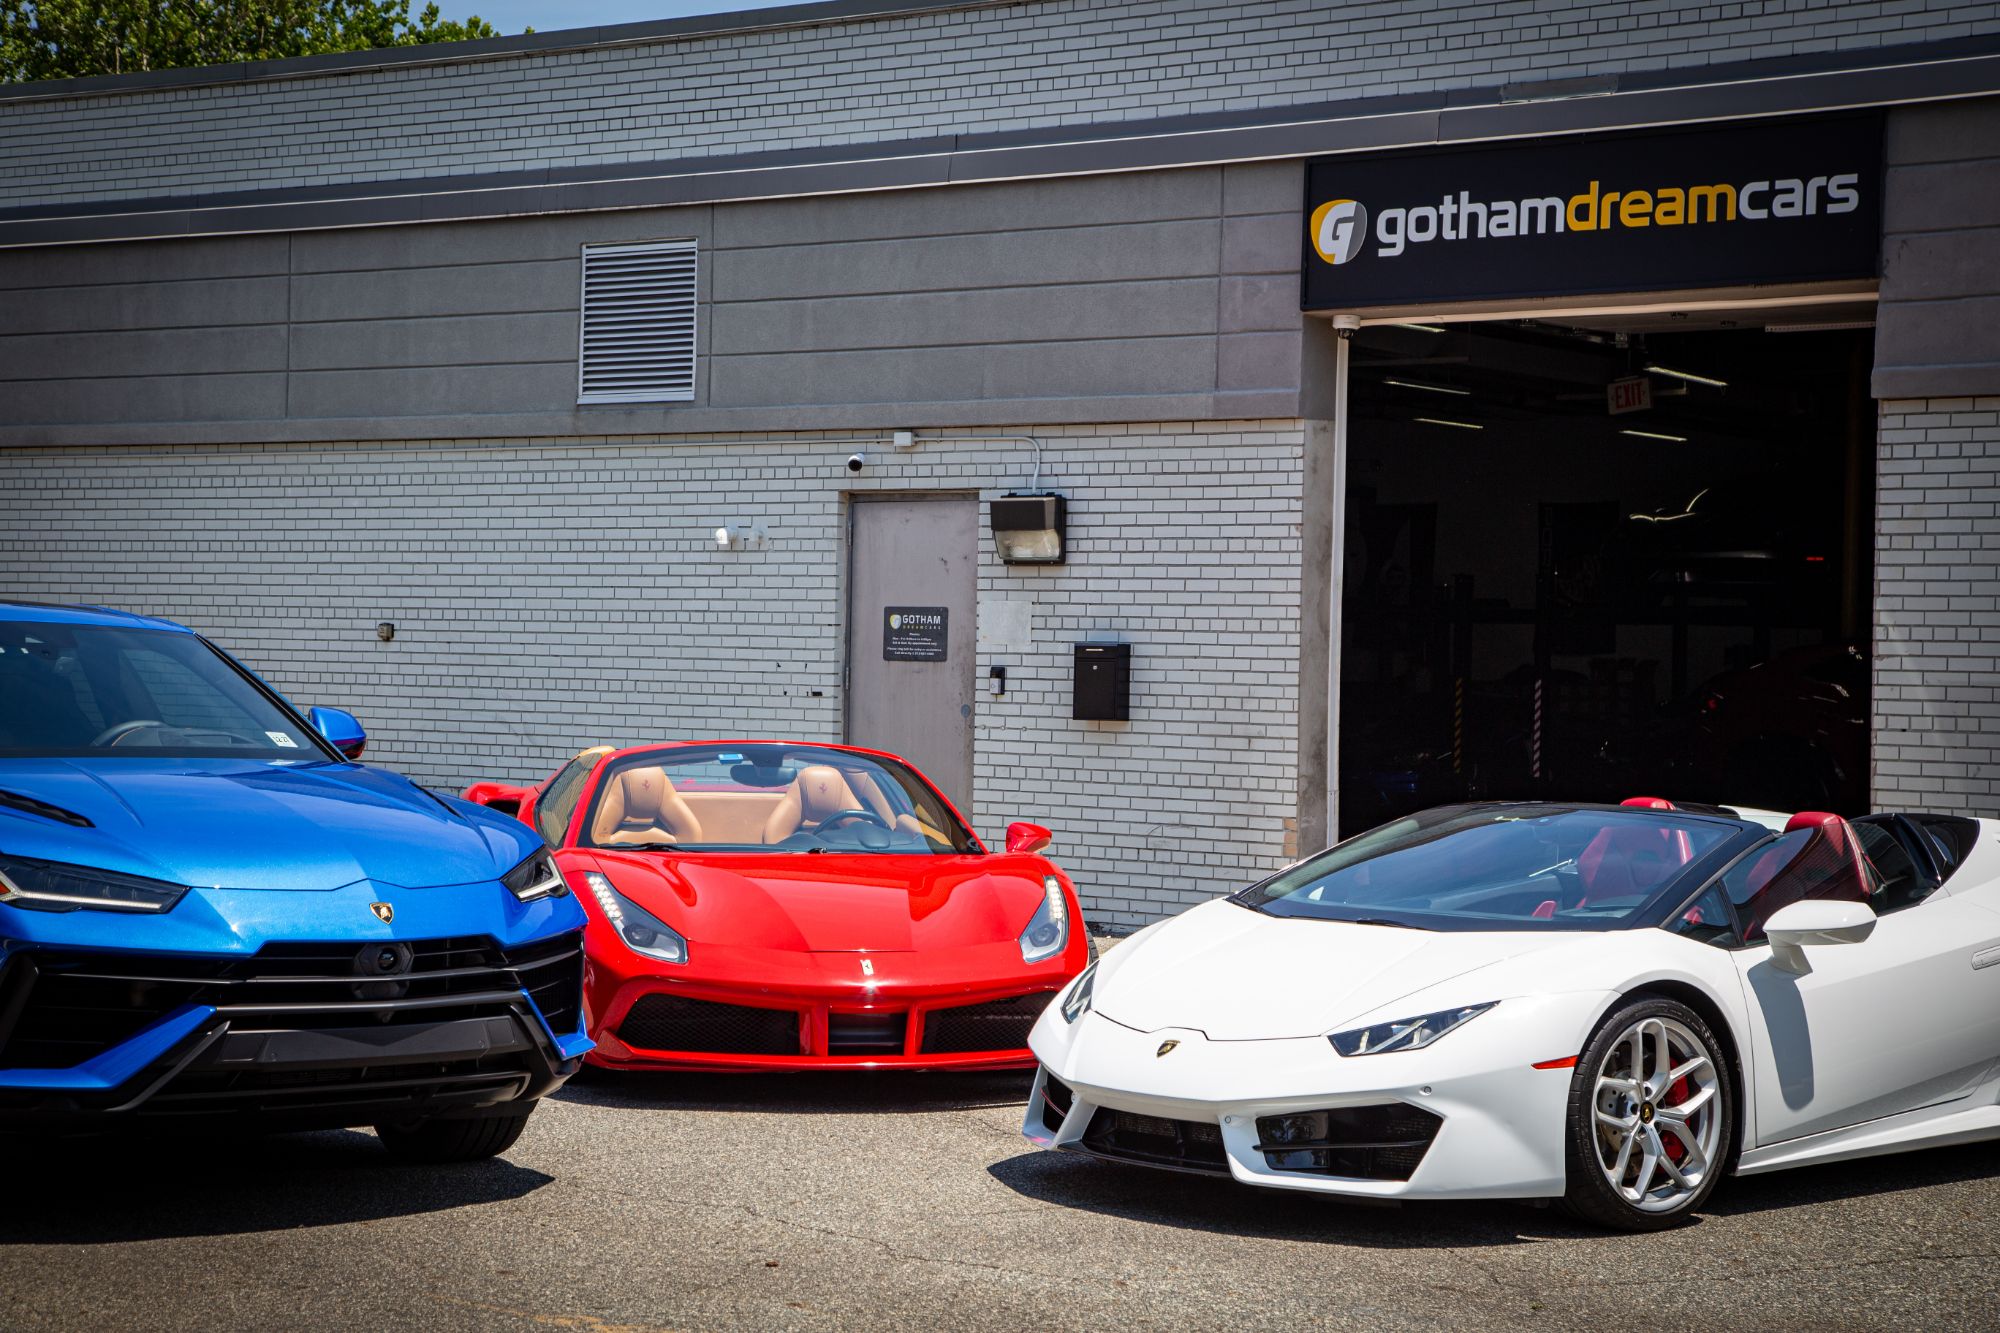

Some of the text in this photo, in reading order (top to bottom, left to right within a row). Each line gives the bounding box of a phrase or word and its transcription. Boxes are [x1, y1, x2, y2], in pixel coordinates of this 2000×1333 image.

[1376, 172, 1859, 258] gothamdreamcars
[1615, 381, 1643, 409] EXIT
[902, 614, 941, 624] GOTHAM
